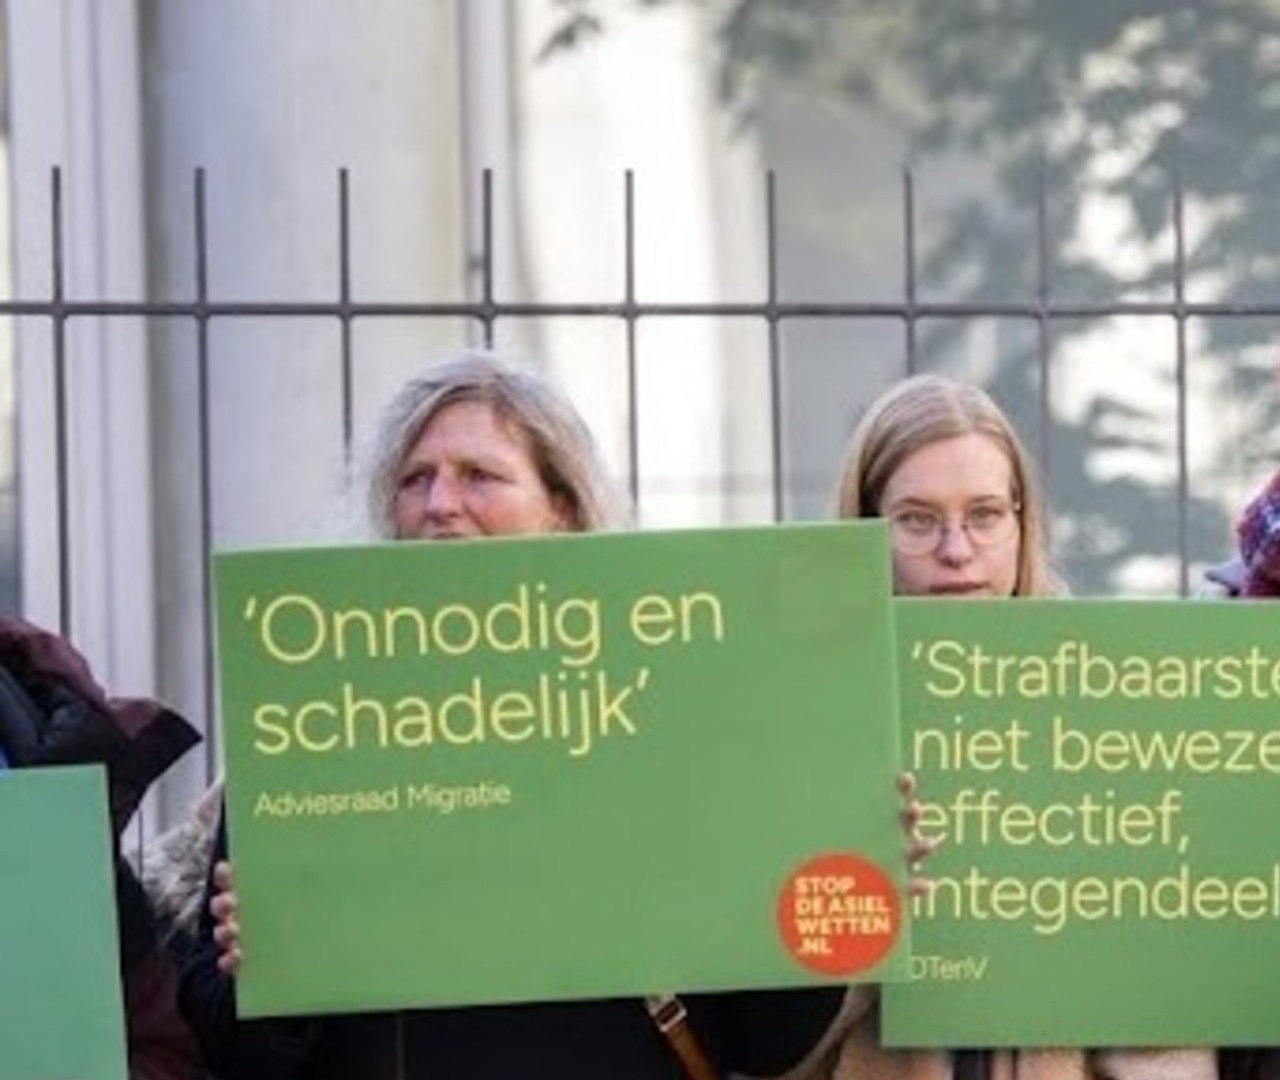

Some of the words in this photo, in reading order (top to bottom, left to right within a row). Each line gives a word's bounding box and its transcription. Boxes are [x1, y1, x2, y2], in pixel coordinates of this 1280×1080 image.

[244, 583, 601, 667] 'Onnodig
[629, 591, 724, 645] en
[254, 668, 649, 756] schadelijk'
[914, 716, 1029, 771] niet
[255, 787, 398, 817] Adviesraad
[408, 782, 511, 813] Migratie
[911, 788, 1189, 852] effectief,
[795, 877, 856, 895] STOP
[795, 897, 824, 915] DE
[829, 895, 891, 914] ASIEL
[796, 915, 891, 935] WETTEN
[797, 937, 834, 955] .NL
